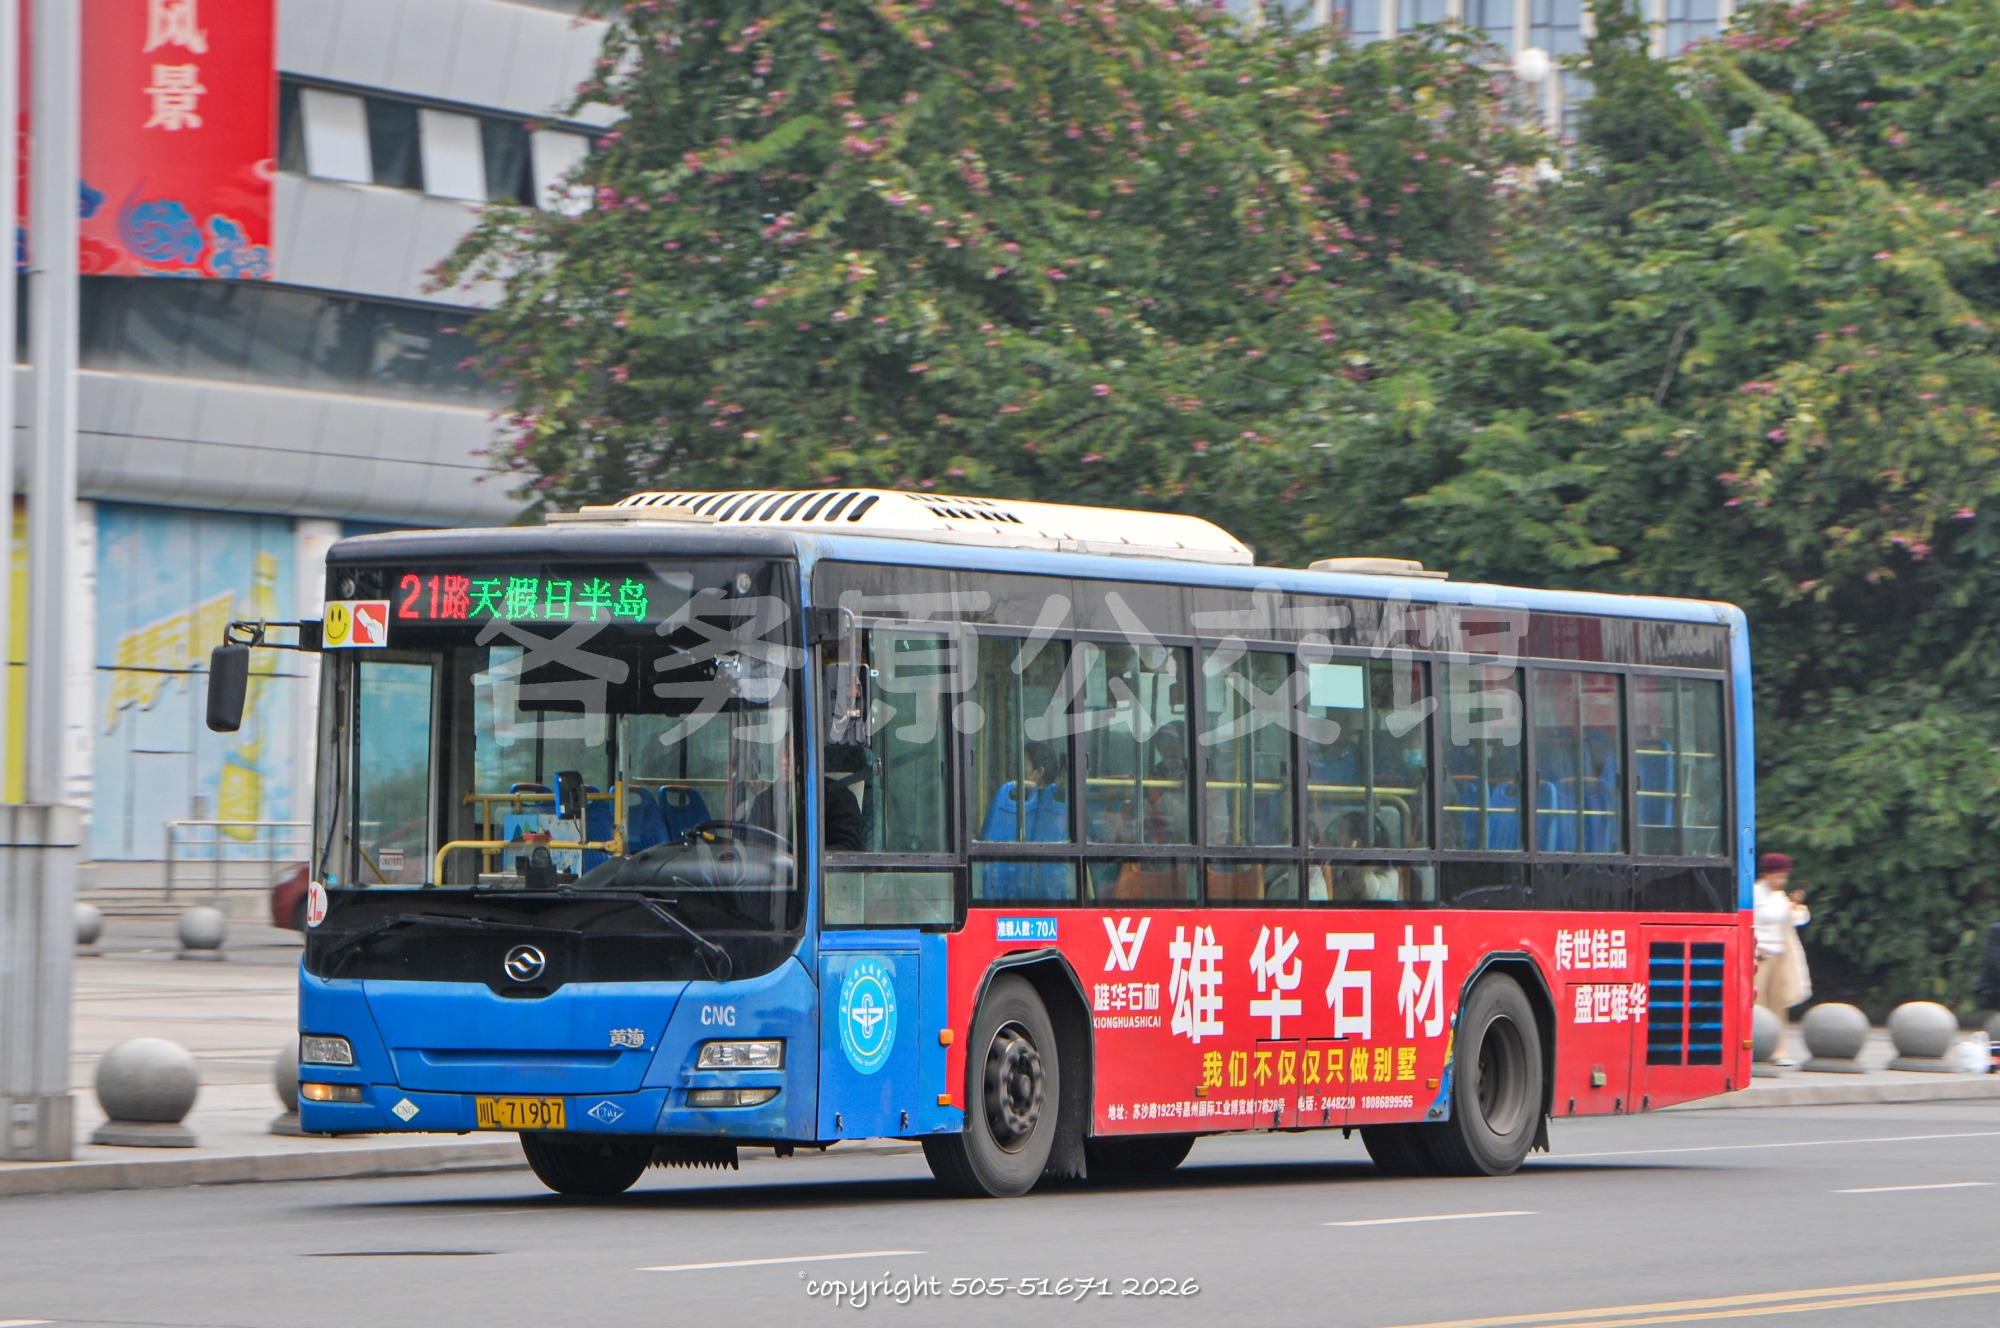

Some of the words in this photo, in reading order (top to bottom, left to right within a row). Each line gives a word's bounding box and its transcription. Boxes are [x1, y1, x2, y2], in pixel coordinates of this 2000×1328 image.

[141, 0, 209, 131] 风景
[1554, 928, 1628, 971] 传世佳品
[1093, 982, 1161, 1012] 雄华石材
[1168, 924, 1449, 1044] 雄华石材
[701, 1005, 736, 1027] CNG
[1573, 982, 1647, 1024] 盛世雄华
[609, 1027, 645, 1048] 黄海
[1093, 1015, 1162, 1029] XIONGHUASHICAI
[1201, 1045, 1418, 1088] 我们不仅仅只做别墅
[396, 1105, 415, 1116] CNG
